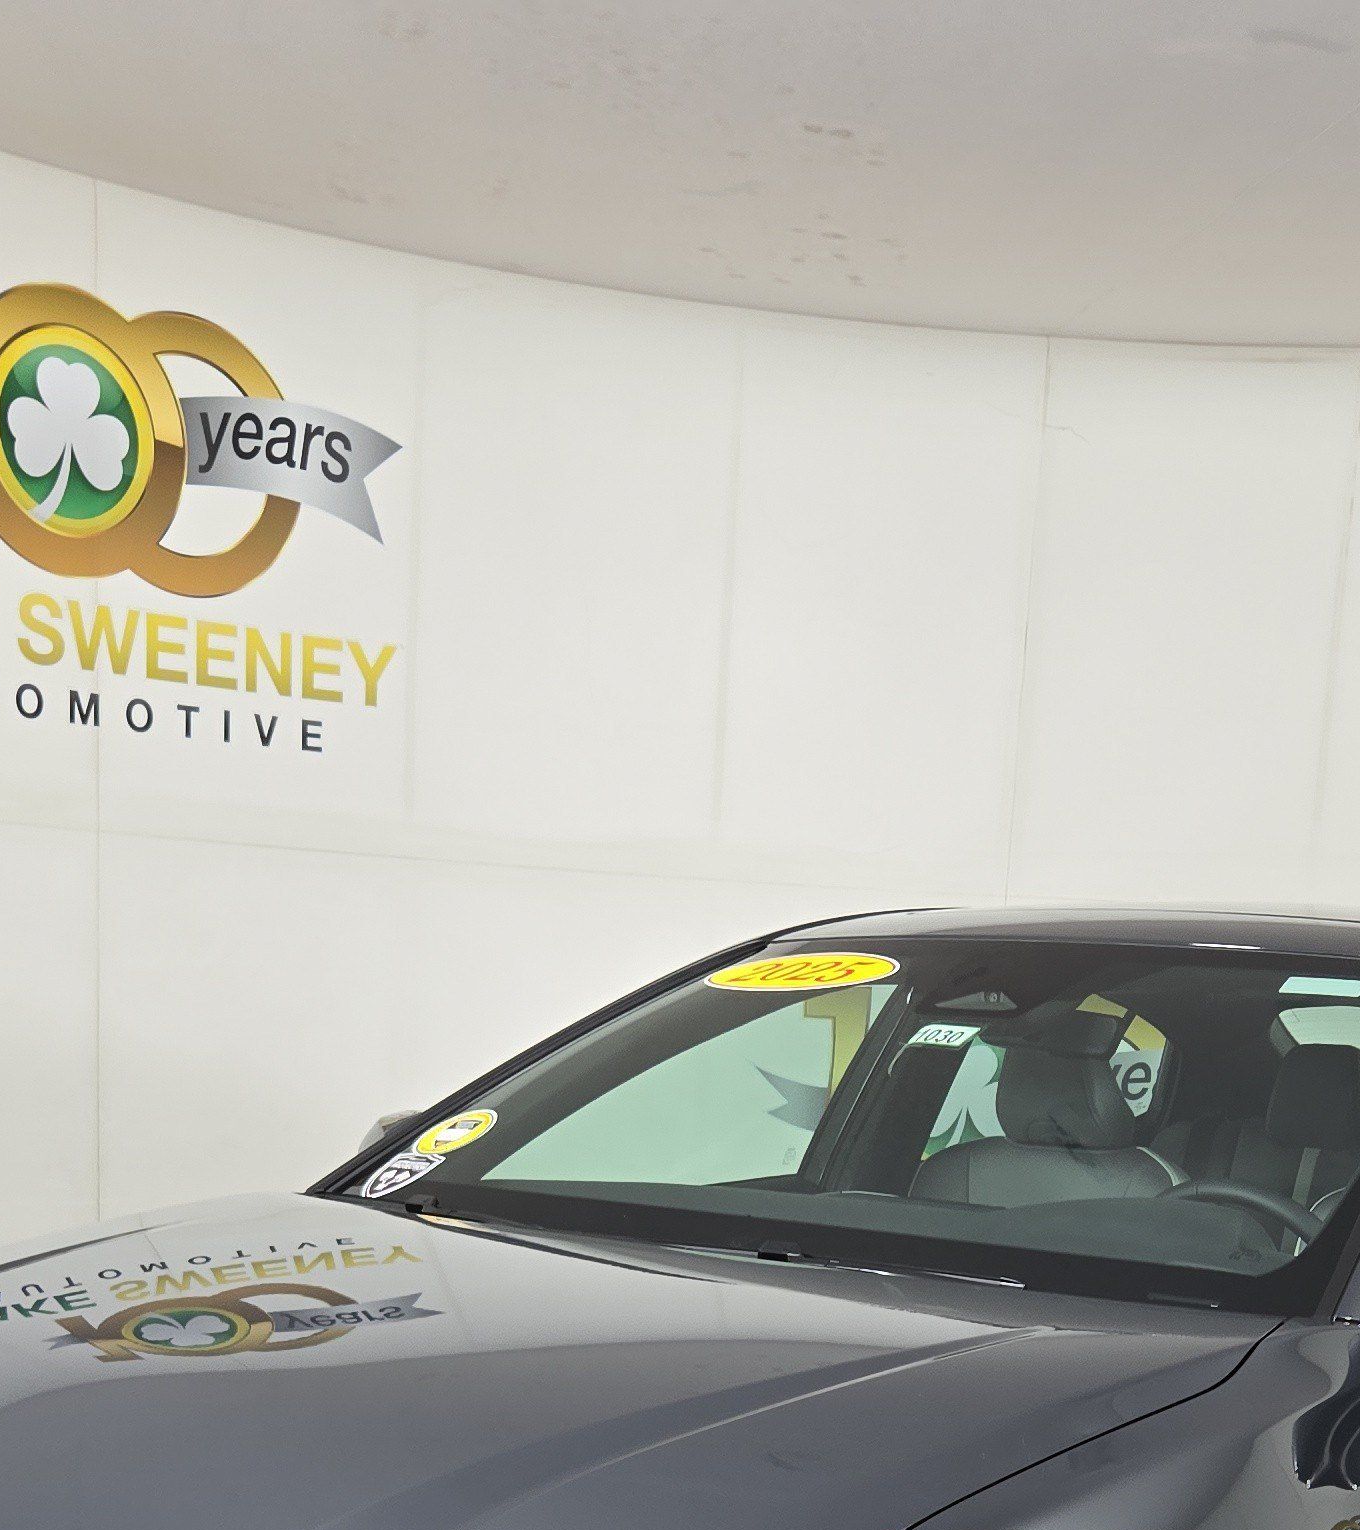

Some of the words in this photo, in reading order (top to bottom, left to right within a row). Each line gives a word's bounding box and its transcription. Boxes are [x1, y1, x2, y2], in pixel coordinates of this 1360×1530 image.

[197, 407, 351, 482] years
[17, 593, 396, 707] SWEENEY
[726, 961, 875, 983] 2025
